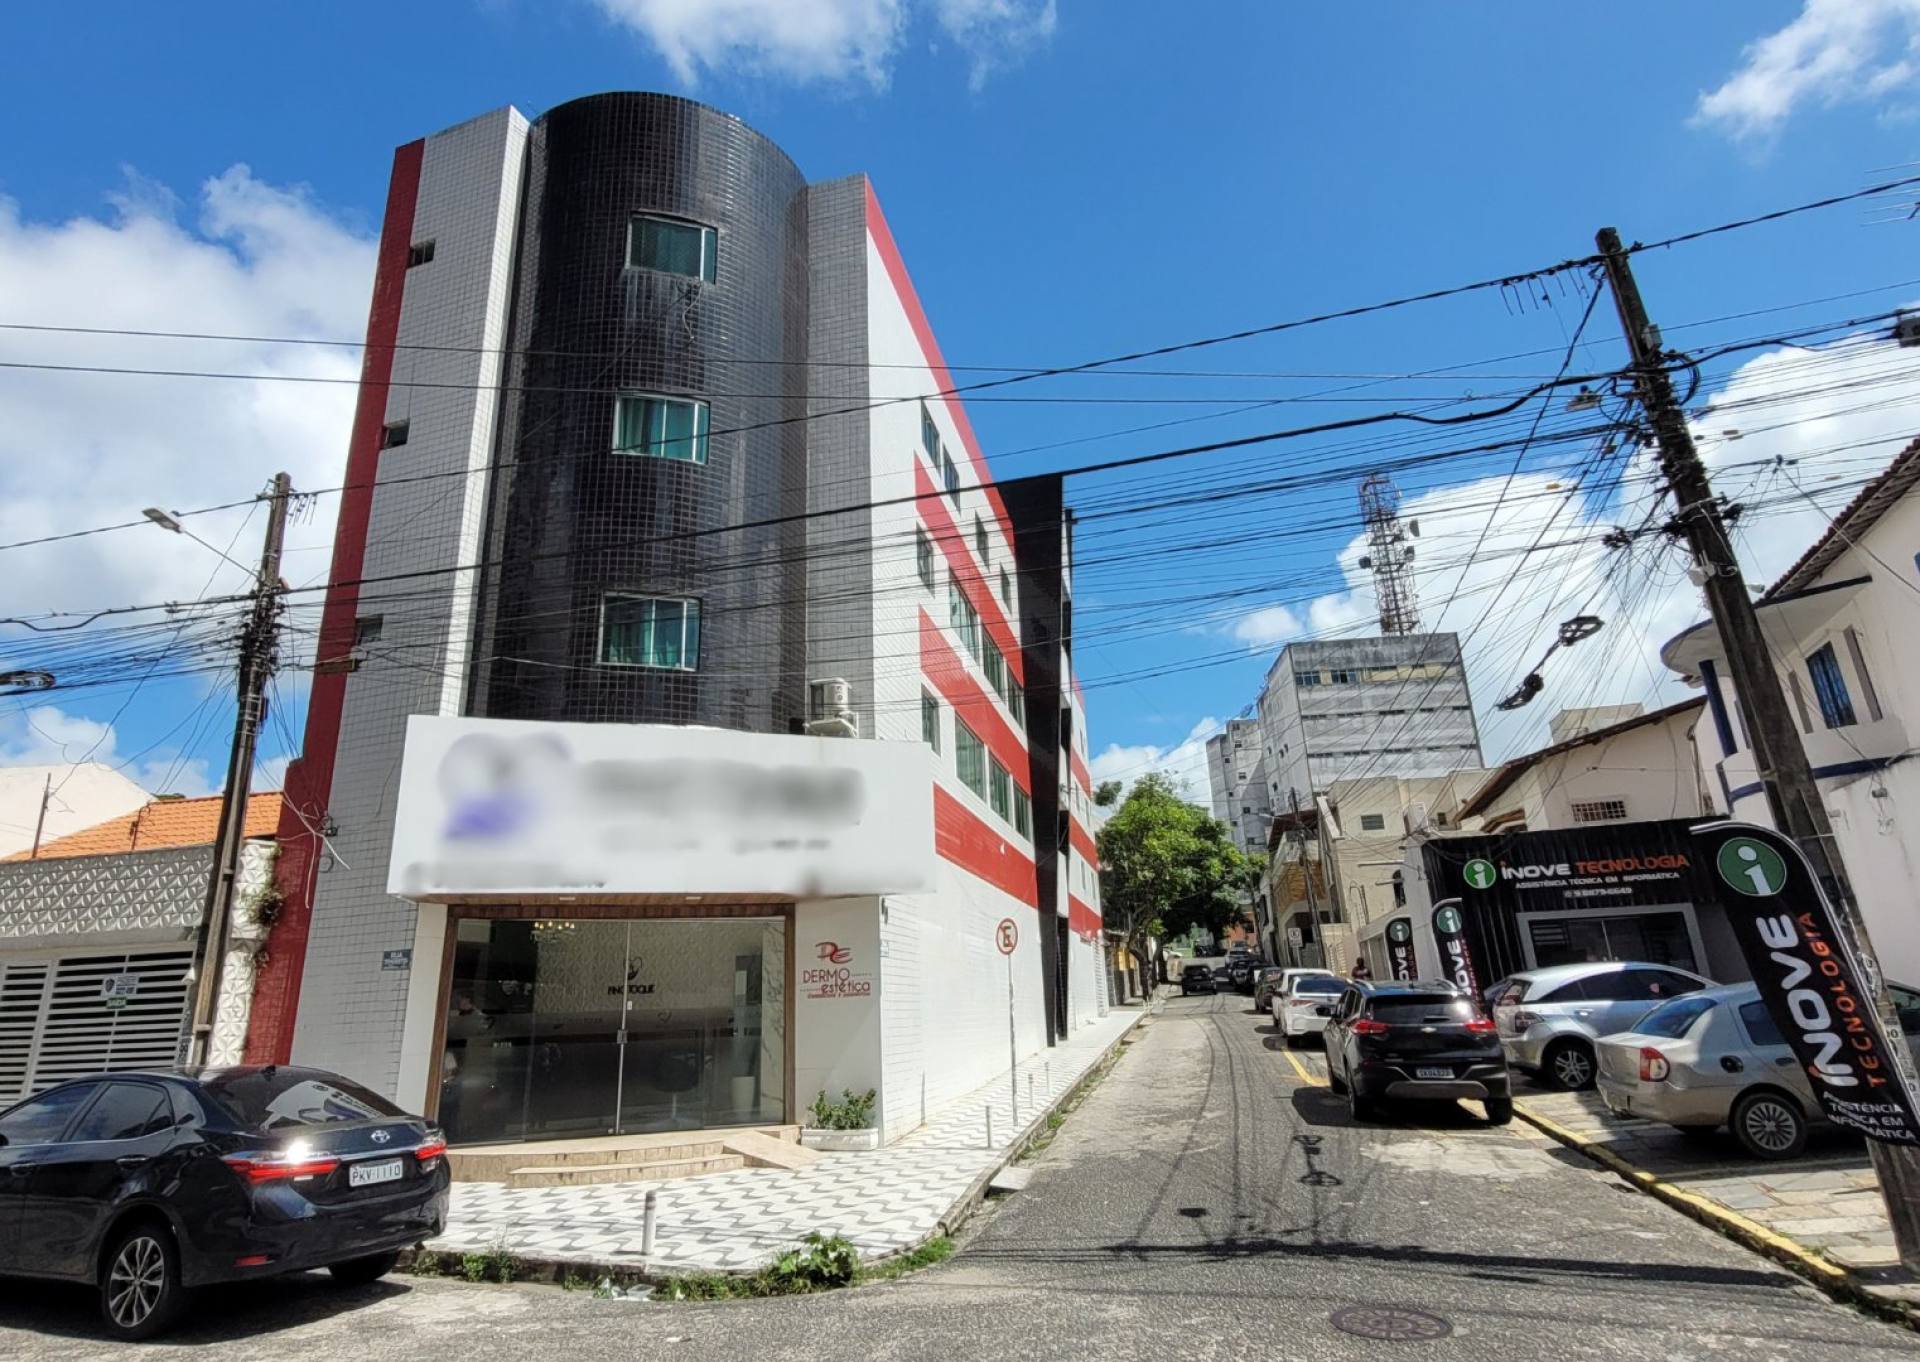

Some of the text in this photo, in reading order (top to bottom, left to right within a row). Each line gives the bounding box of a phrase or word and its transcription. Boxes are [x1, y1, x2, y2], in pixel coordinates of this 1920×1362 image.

[1575, 854, 1690, 875] TECNOLOGIA
[803, 968, 850, 983] DERMO
[1395, 946, 1410, 980] OVE
[1447, 939, 1472, 995] OVE
[1800, 912, 1887, 1088] TECNOLOGIA
[1881, 1116, 1904, 1126] EM
